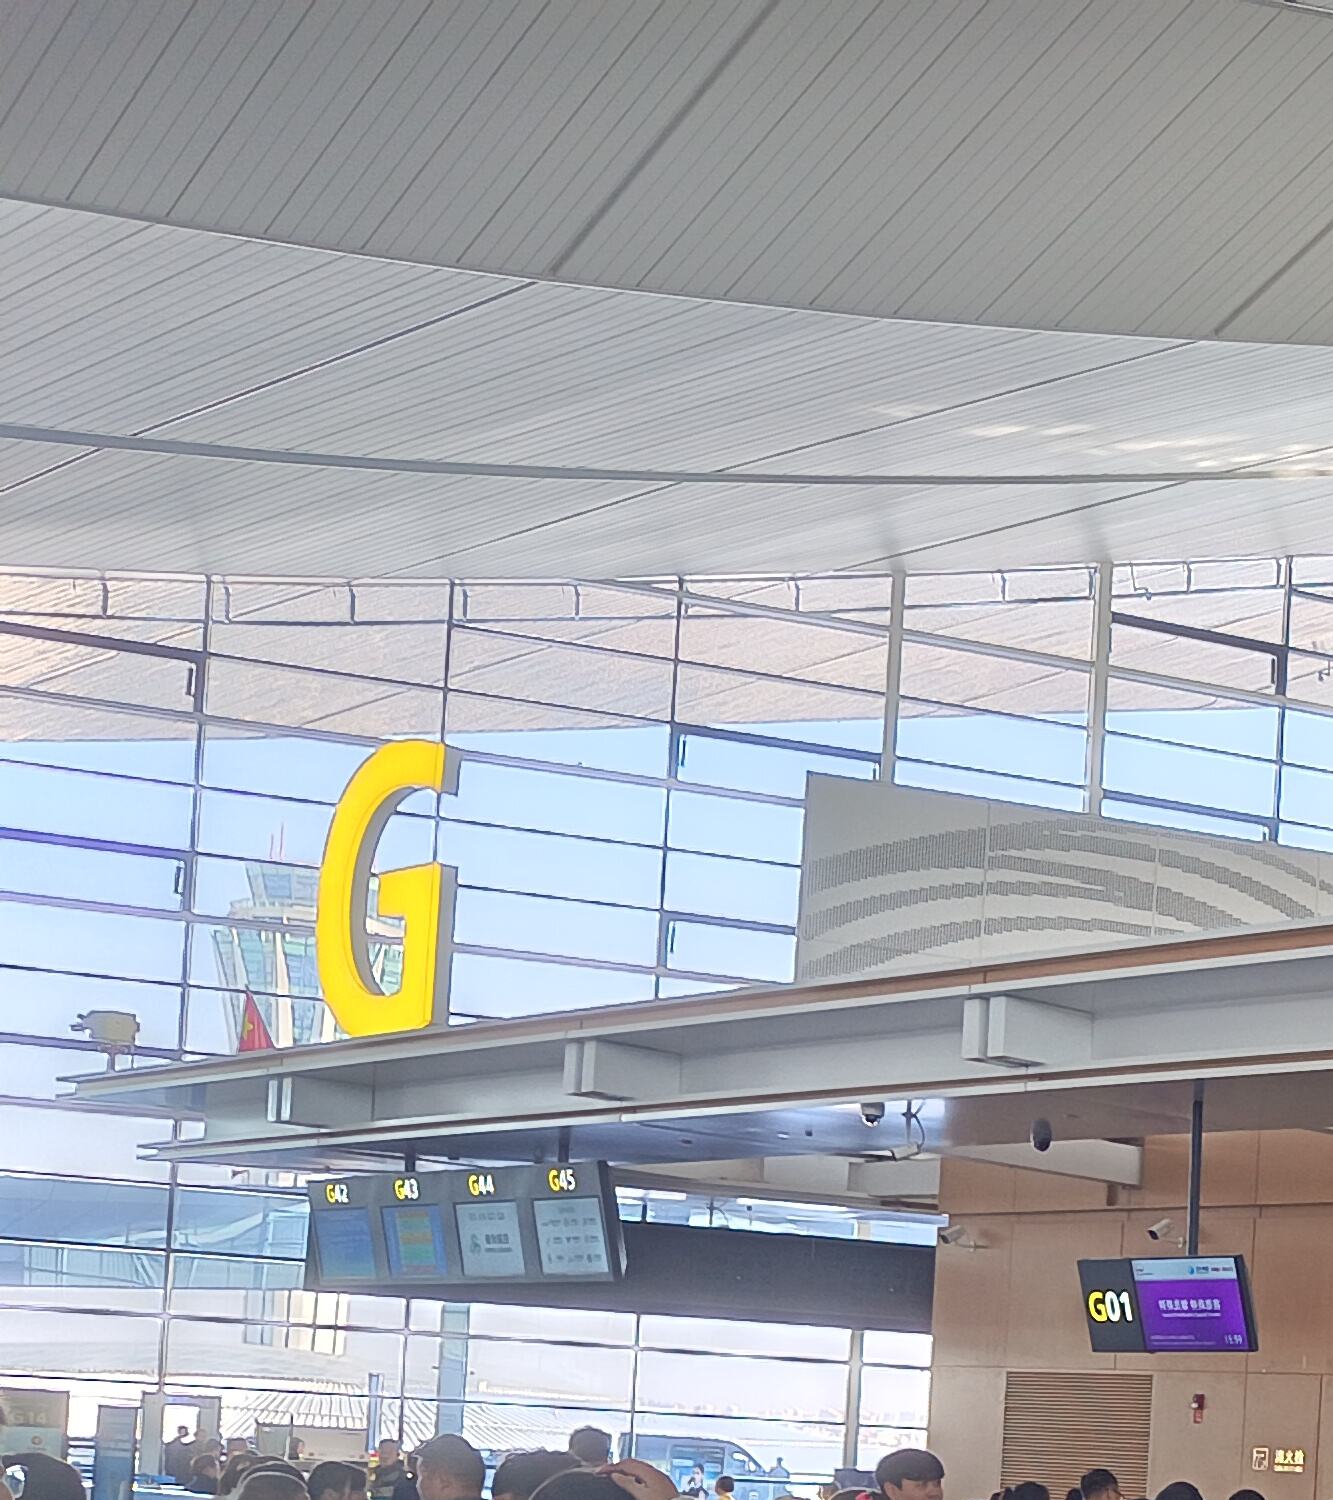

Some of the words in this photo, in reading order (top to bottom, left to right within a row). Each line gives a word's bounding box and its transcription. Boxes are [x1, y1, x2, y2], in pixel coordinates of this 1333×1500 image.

[317, 739, 458, 1037] G
[394, 1178, 419, 1200] G43
[468, 1174, 495, 1196] G44
[549, 1169, 576, 1192] G45
[326, 1184, 349, 1203] G42
[1088, 1291, 1133, 1322] G01
